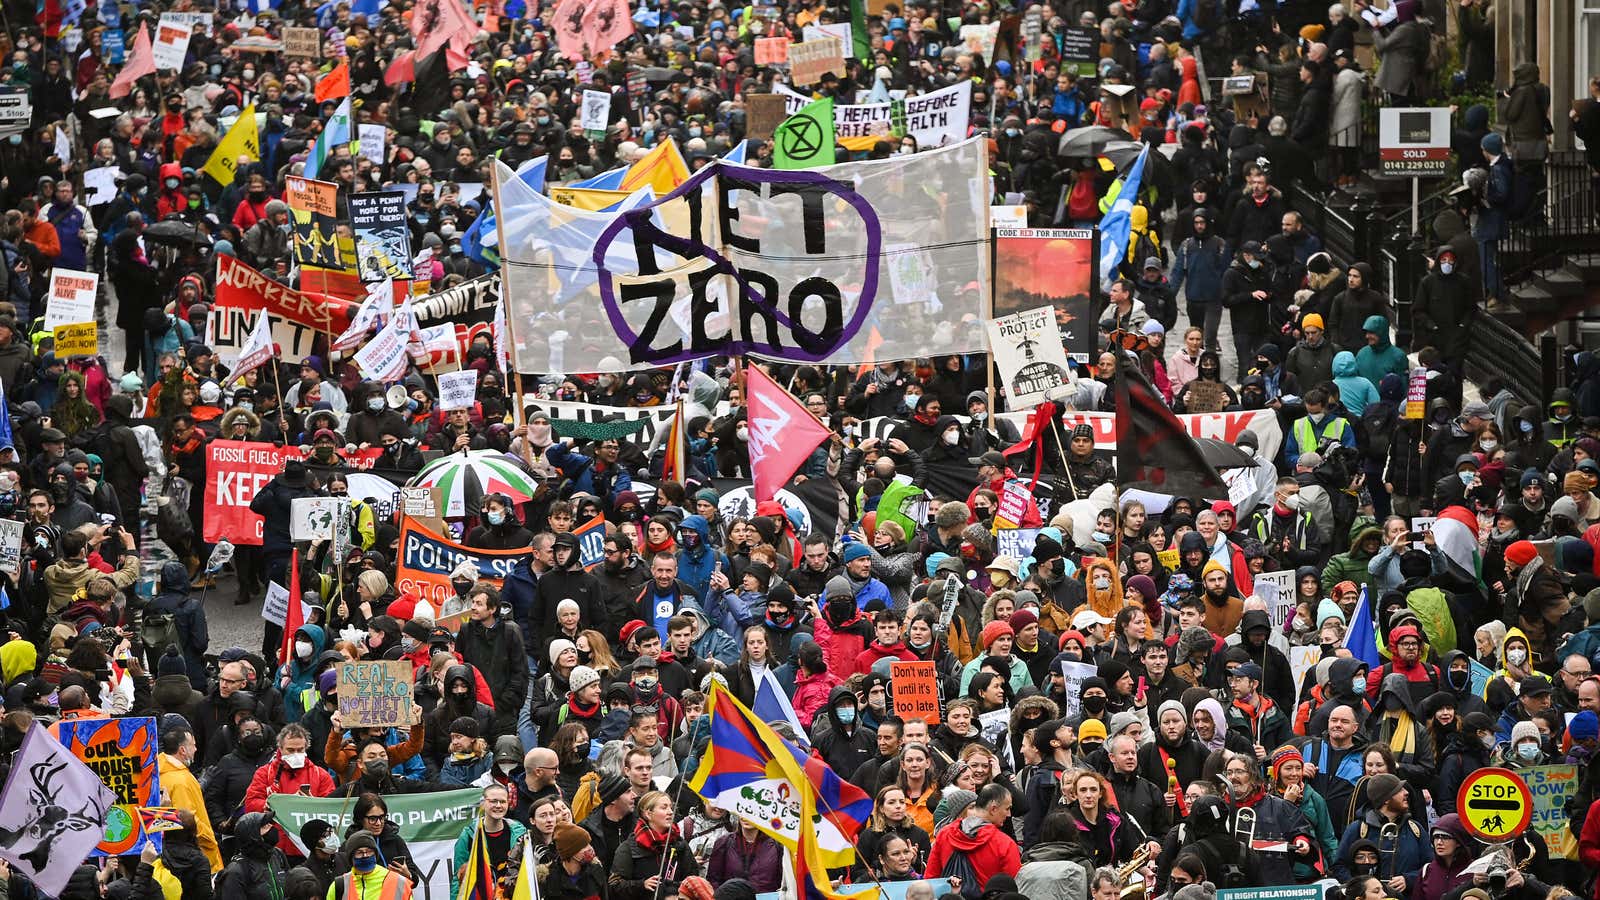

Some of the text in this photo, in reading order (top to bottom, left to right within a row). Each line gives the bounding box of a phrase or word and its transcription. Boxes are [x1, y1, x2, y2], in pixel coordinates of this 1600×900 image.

[906, 91, 959, 115] BEFORE
[1403, 150, 1427, 158] SOLD
[1384, 161, 1445, 169] 0141 229 0210
[290, 180, 306, 192] NO
[380, 196, 403, 205] PENNY
[360, 207, 379, 215] MORE
[380, 213, 404, 222] ENERGY
[627, 172, 855, 275] NET
[1052, 230, 1091, 238] HUMANITY
[55, 276, 73, 286] KEEP
[55, 288, 76, 300] ALIVE
[216, 257, 341, 323] WORKERS
[621, 262, 844, 364] ZERO
[68, 328, 94, 338] CLIMATE
[1000, 317, 1048, 337] PROTECT
[1022, 364, 1048, 376] WATER
[1019, 380, 1036, 394] NO
[1036, 376, 1055, 391] LINE
[213, 448, 247, 463] FOSSIL
[249, 450, 279, 466] FUELS
[216, 471, 277, 507] KEE
[1003, 492, 1023, 506] Climate
[998, 530, 1019, 539] NO
[999, 539, 1032, 549] NEW
[1000, 547, 1023, 558] OIL
[1278, 589, 1294, 600] MY
[342, 662, 395, 684] REAL
[894, 665, 935, 678] Don't wait
[357, 681, 409, 697] ZERO
[898, 683, 916, 695] until
[918, 683, 931, 695] it's
[339, 696, 369, 715] NOT
[372, 697, 400, 712] NET
[896, 700, 938, 712] too late.
[360, 711, 398, 724] ZERO
[84, 739, 124, 759] OUR
[114, 774, 132, 785] ON
[1519, 769, 1545, 783] T'S
[1472, 785, 1517, 798] STOP
[408, 804, 480, 825] PLANET
[1224, 888, 1318, 900] IN RIGHT RELATIONSHIP
